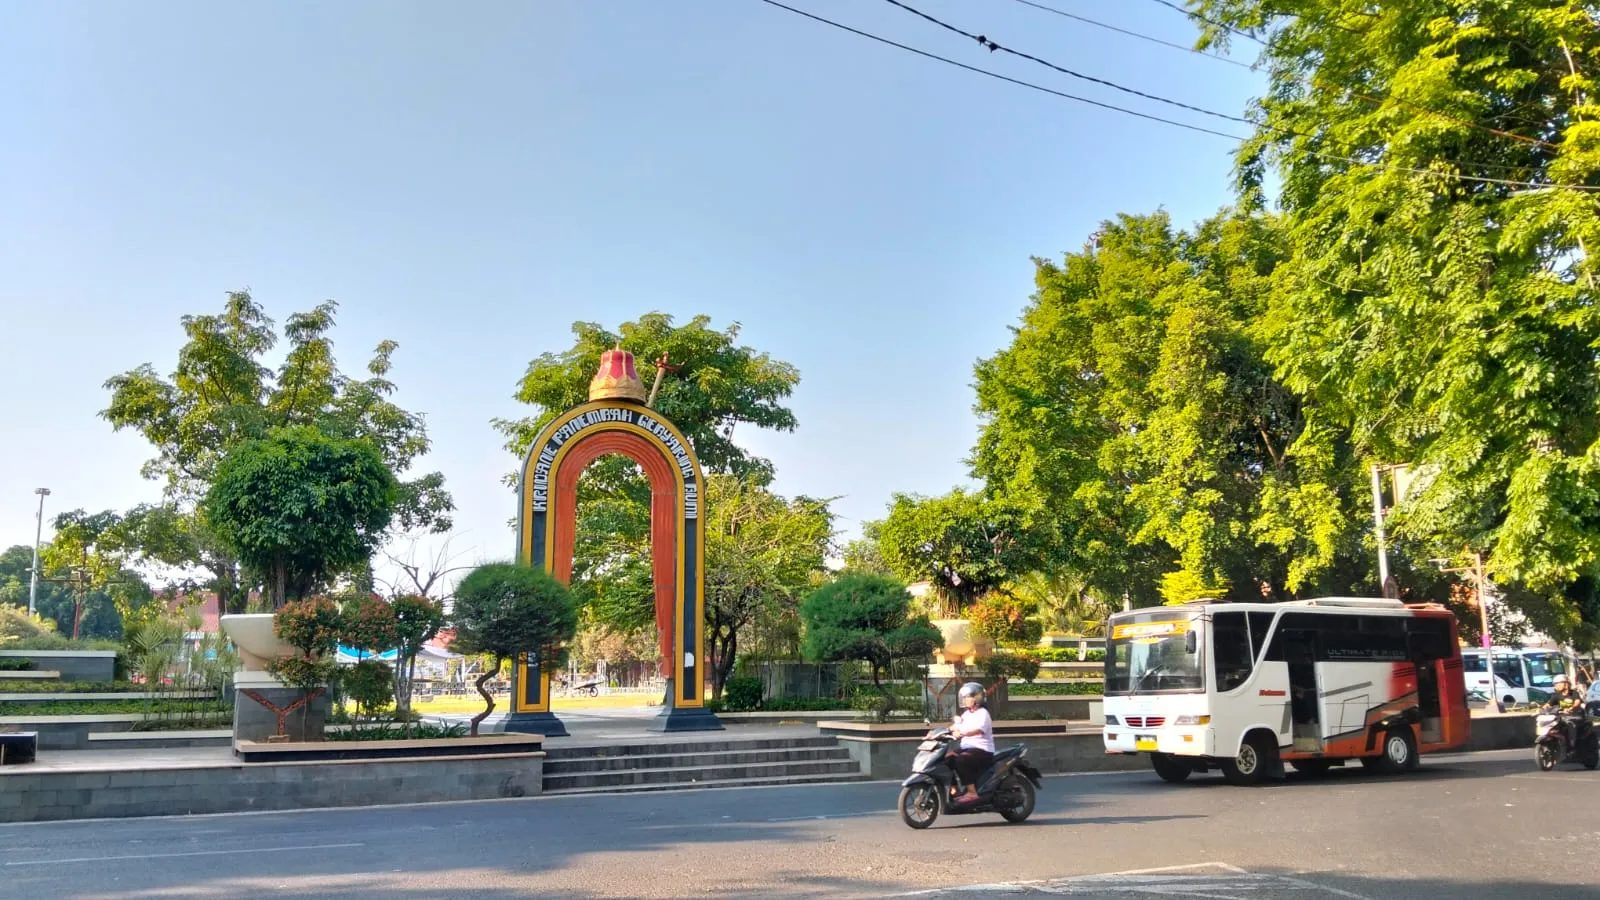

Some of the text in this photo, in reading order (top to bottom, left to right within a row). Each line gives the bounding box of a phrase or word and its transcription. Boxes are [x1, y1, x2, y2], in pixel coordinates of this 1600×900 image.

[532, 445, 558, 512] KRIDANE
[551, 408, 633, 446] PANEMBAH
[638, 414, 695, 479] GEBYARING
